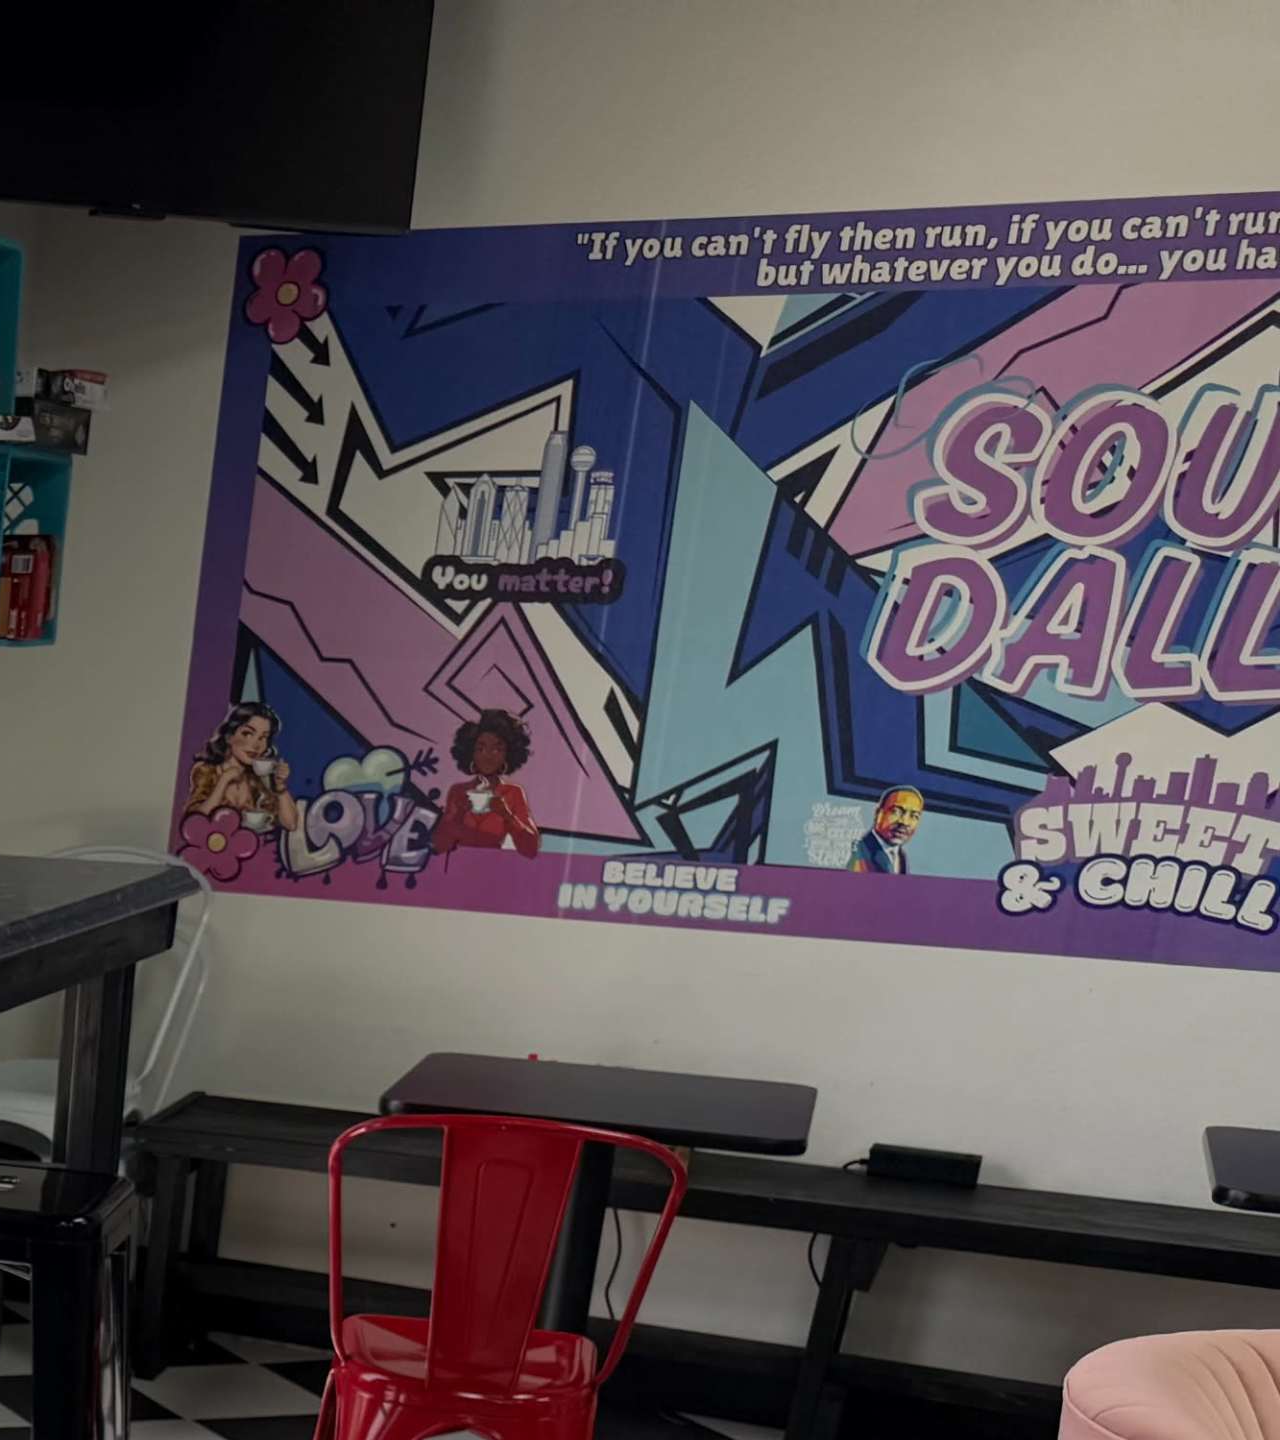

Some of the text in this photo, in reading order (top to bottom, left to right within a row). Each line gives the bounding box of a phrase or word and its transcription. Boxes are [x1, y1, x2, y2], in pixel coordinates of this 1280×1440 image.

[576, 231, 621, 261] "If
[624, 234, 682, 266] you
[691, 226, 778, 257] can't
[785, 223, 831, 259] fly
[839, 221, 916, 251] then
[924, 222, 998, 250] run,
[1007, 213, 1040, 245] if
[1044, 217, 1113, 251] you
[1122, 206, 1221, 242] can't
[756, 257, 814, 287] but
[821, 254, 988, 287] whatever
[995, 253, 1063, 286] you
[1071, 245, 1148, 277] do...
[1157, 249, 1227, 280] you
[912, 388, 1280, 550] SOU
[431, 565, 615, 594] You matter!
[867, 543, 1280, 702] DALL
[280, 788, 439, 877] LOVE
[1019, 801, 1280, 876] SWEET
[557, 882, 791, 924] IN YOURSELF
[602, 860, 739, 892] BELIEVE
[1000, 857, 1277, 932] & CHILL
